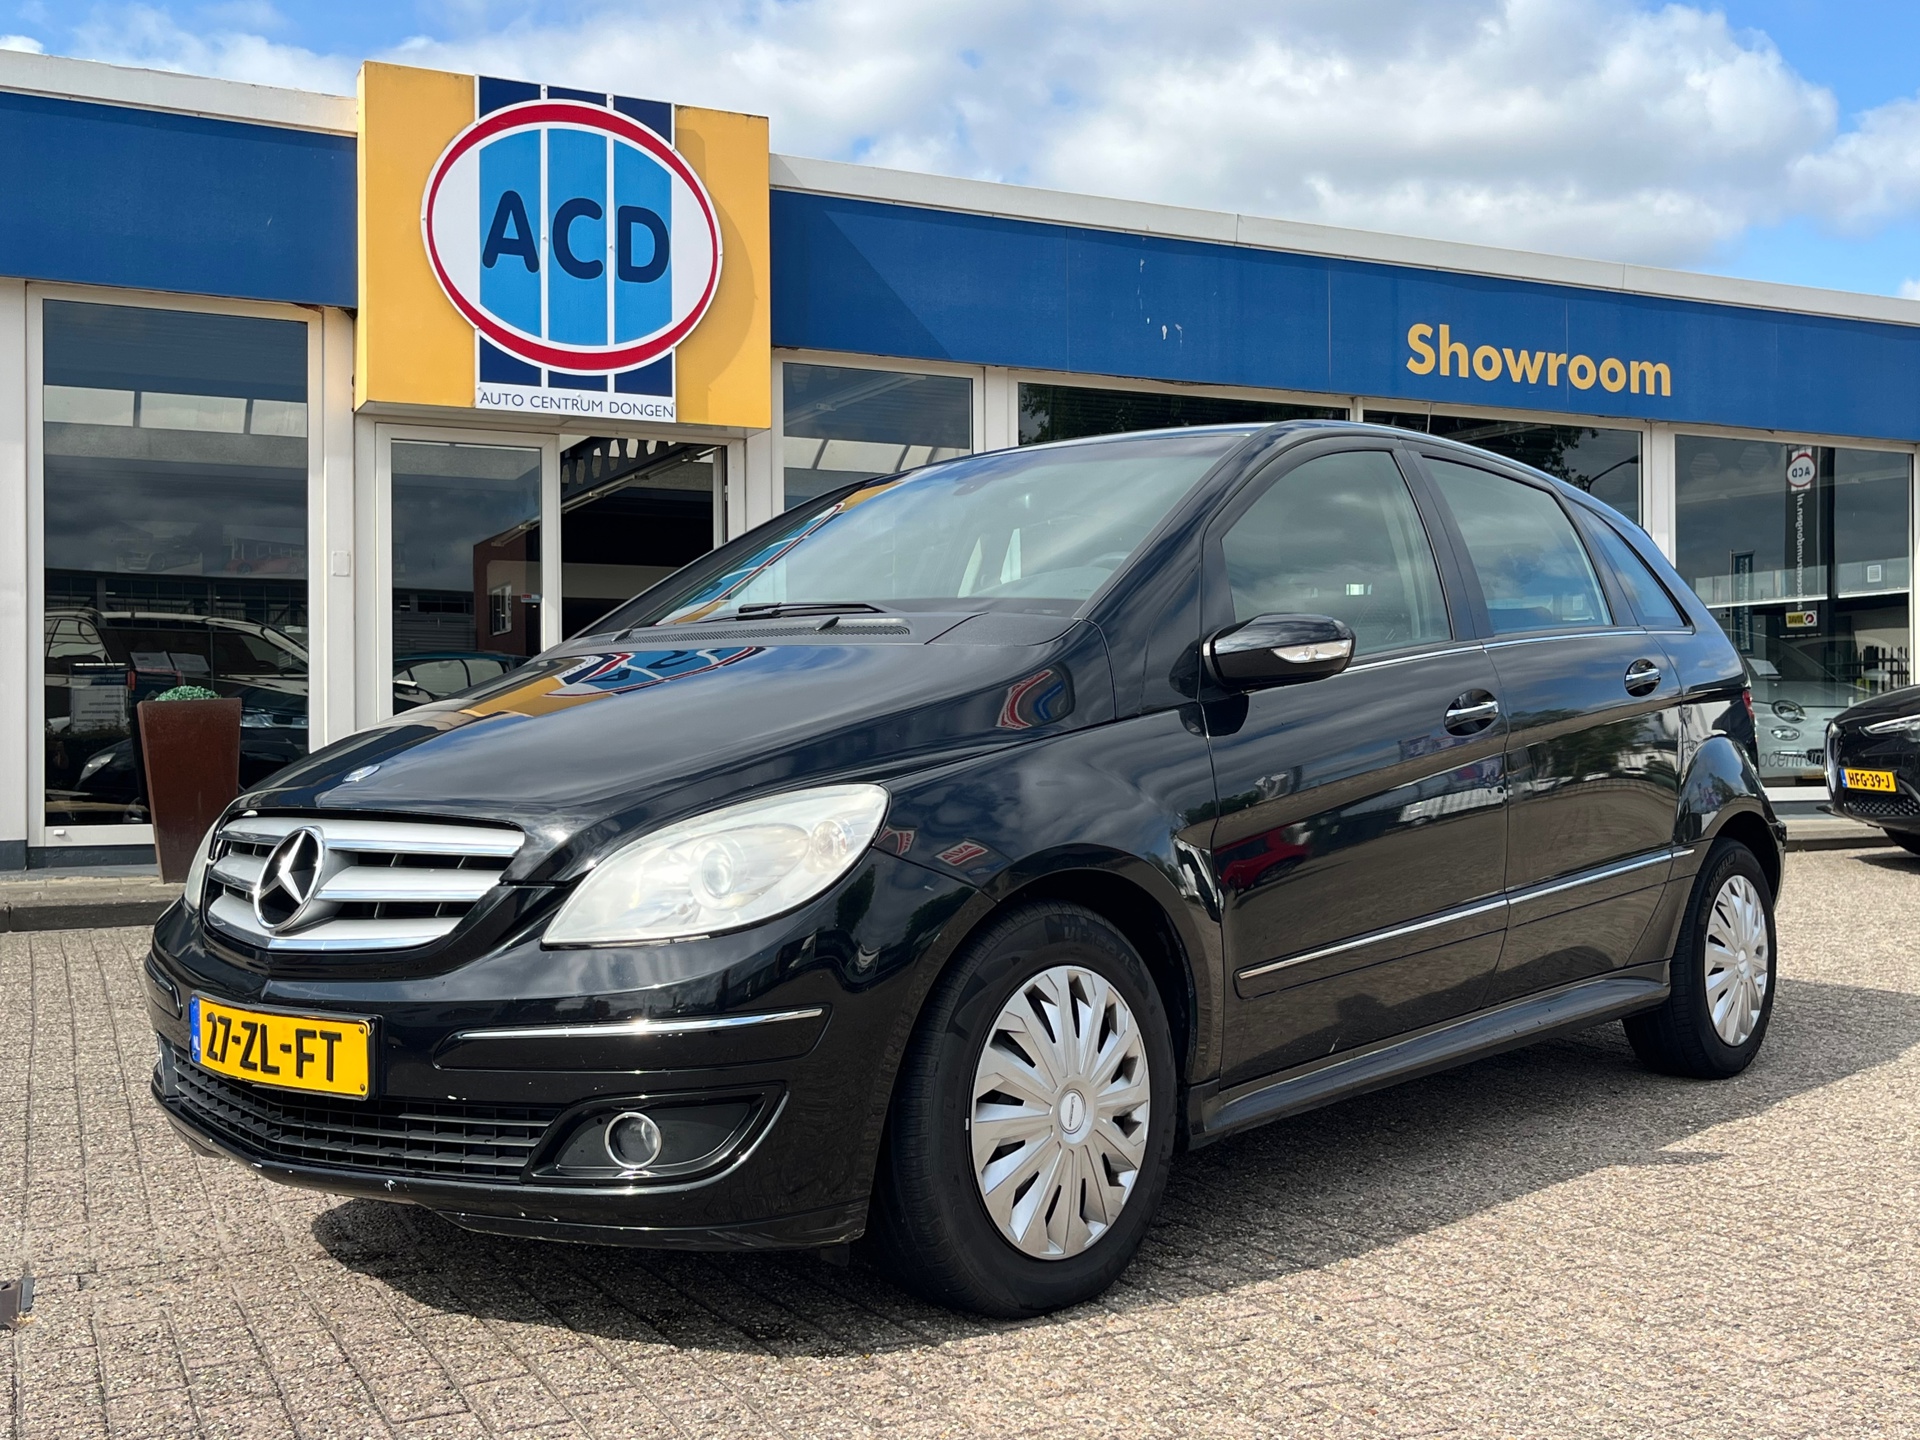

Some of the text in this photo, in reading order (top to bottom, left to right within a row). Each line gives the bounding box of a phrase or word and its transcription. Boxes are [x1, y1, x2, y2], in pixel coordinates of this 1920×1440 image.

[482, 190, 670, 283] ACD
[1406, 323, 1671, 396] Showroom
[480, 392, 674, 418] AUTO CENTRUM DONGEN
[1848, 772, 1890, 789] HFG-39-J
[192, 1035, 201, 1051] NL
[206, 1011, 342, 1083] 27-ZL-FT
